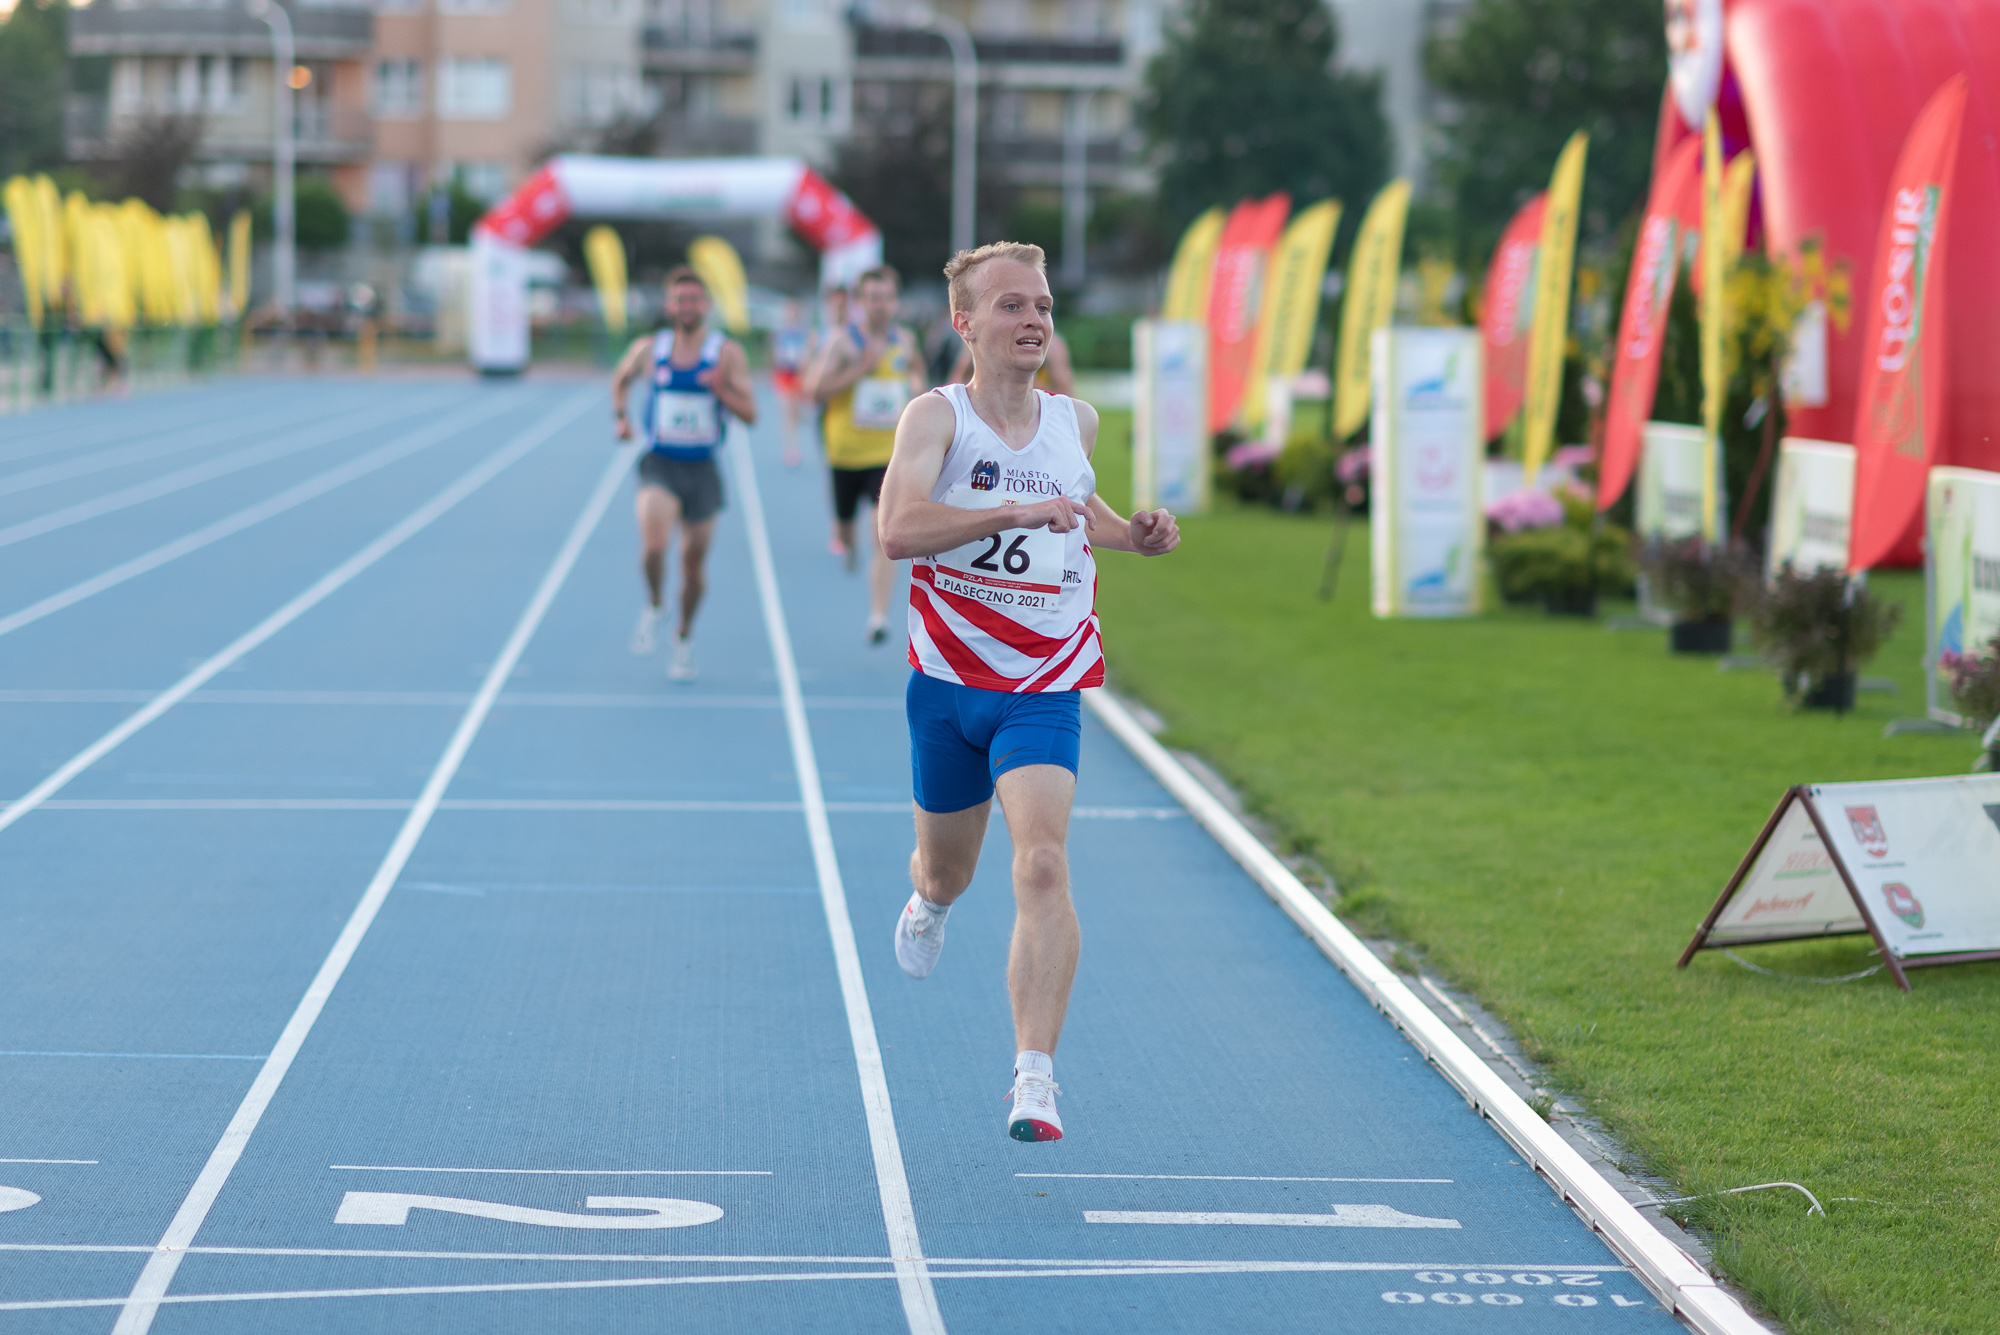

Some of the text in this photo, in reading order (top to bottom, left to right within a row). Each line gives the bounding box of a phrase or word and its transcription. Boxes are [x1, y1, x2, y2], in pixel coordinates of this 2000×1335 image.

[1006, 468, 1050, 480] MIASTO
[1004, 478, 1062, 496] TORUŃ
[970, 532, 1030, 575] 26
[962, 573, 984, 584] PZLA
[943, 578, 1014, 604] PIASECZNO
[1017, 594, 1045, 608] 2021
[333, 1190, 725, 1230] 2
[1082, 1203, 1463, 1230] 1
[1414, 1271, 1603, 1287] 2000
